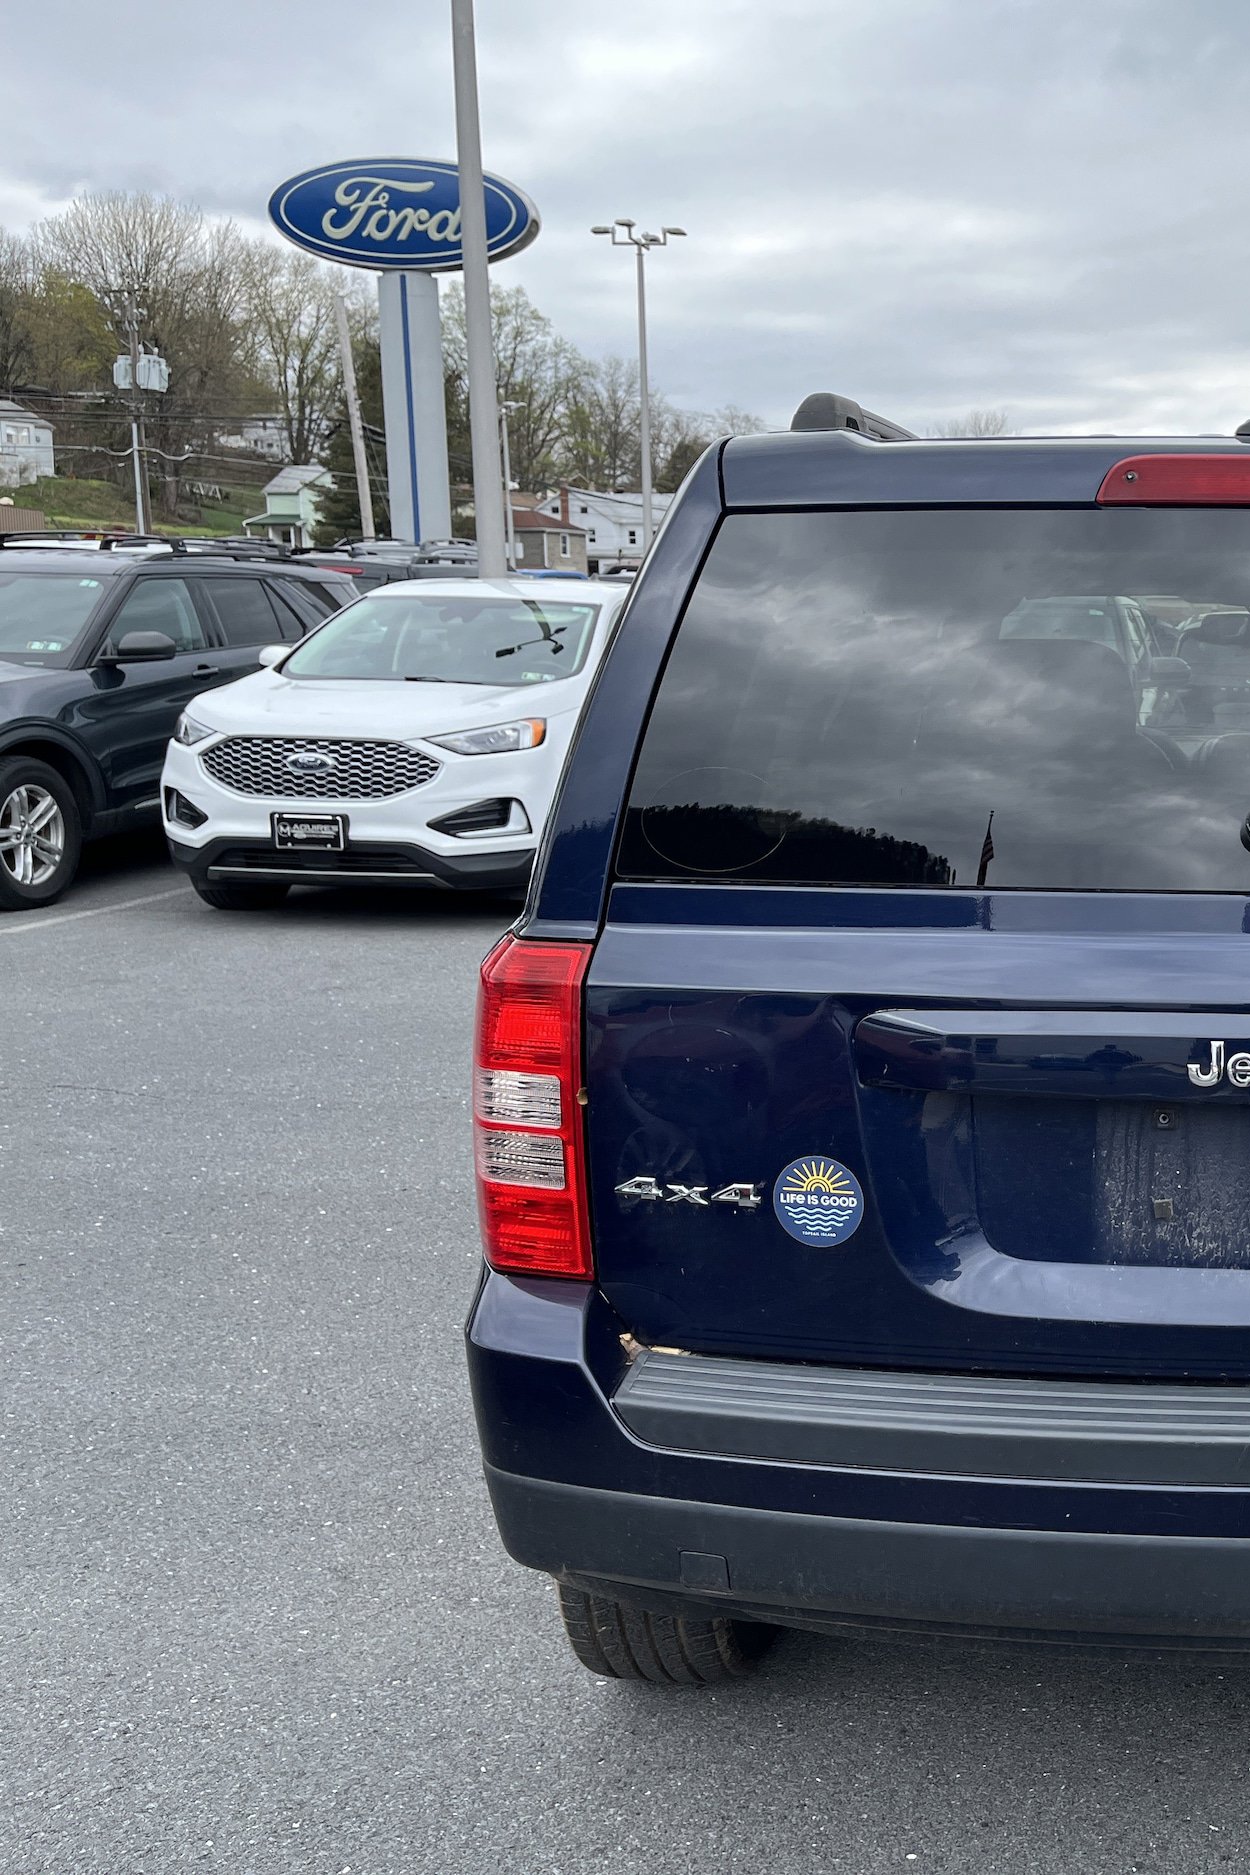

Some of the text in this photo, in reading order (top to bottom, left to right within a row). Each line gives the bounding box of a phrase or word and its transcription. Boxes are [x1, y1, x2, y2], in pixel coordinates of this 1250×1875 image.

[321, 176, 463, 242] Ford
[613, 1175, 763, 1208] 4x4
[807, 1194, 819, 1205] IS
[820, 1195, 858, 1208] GOOD
